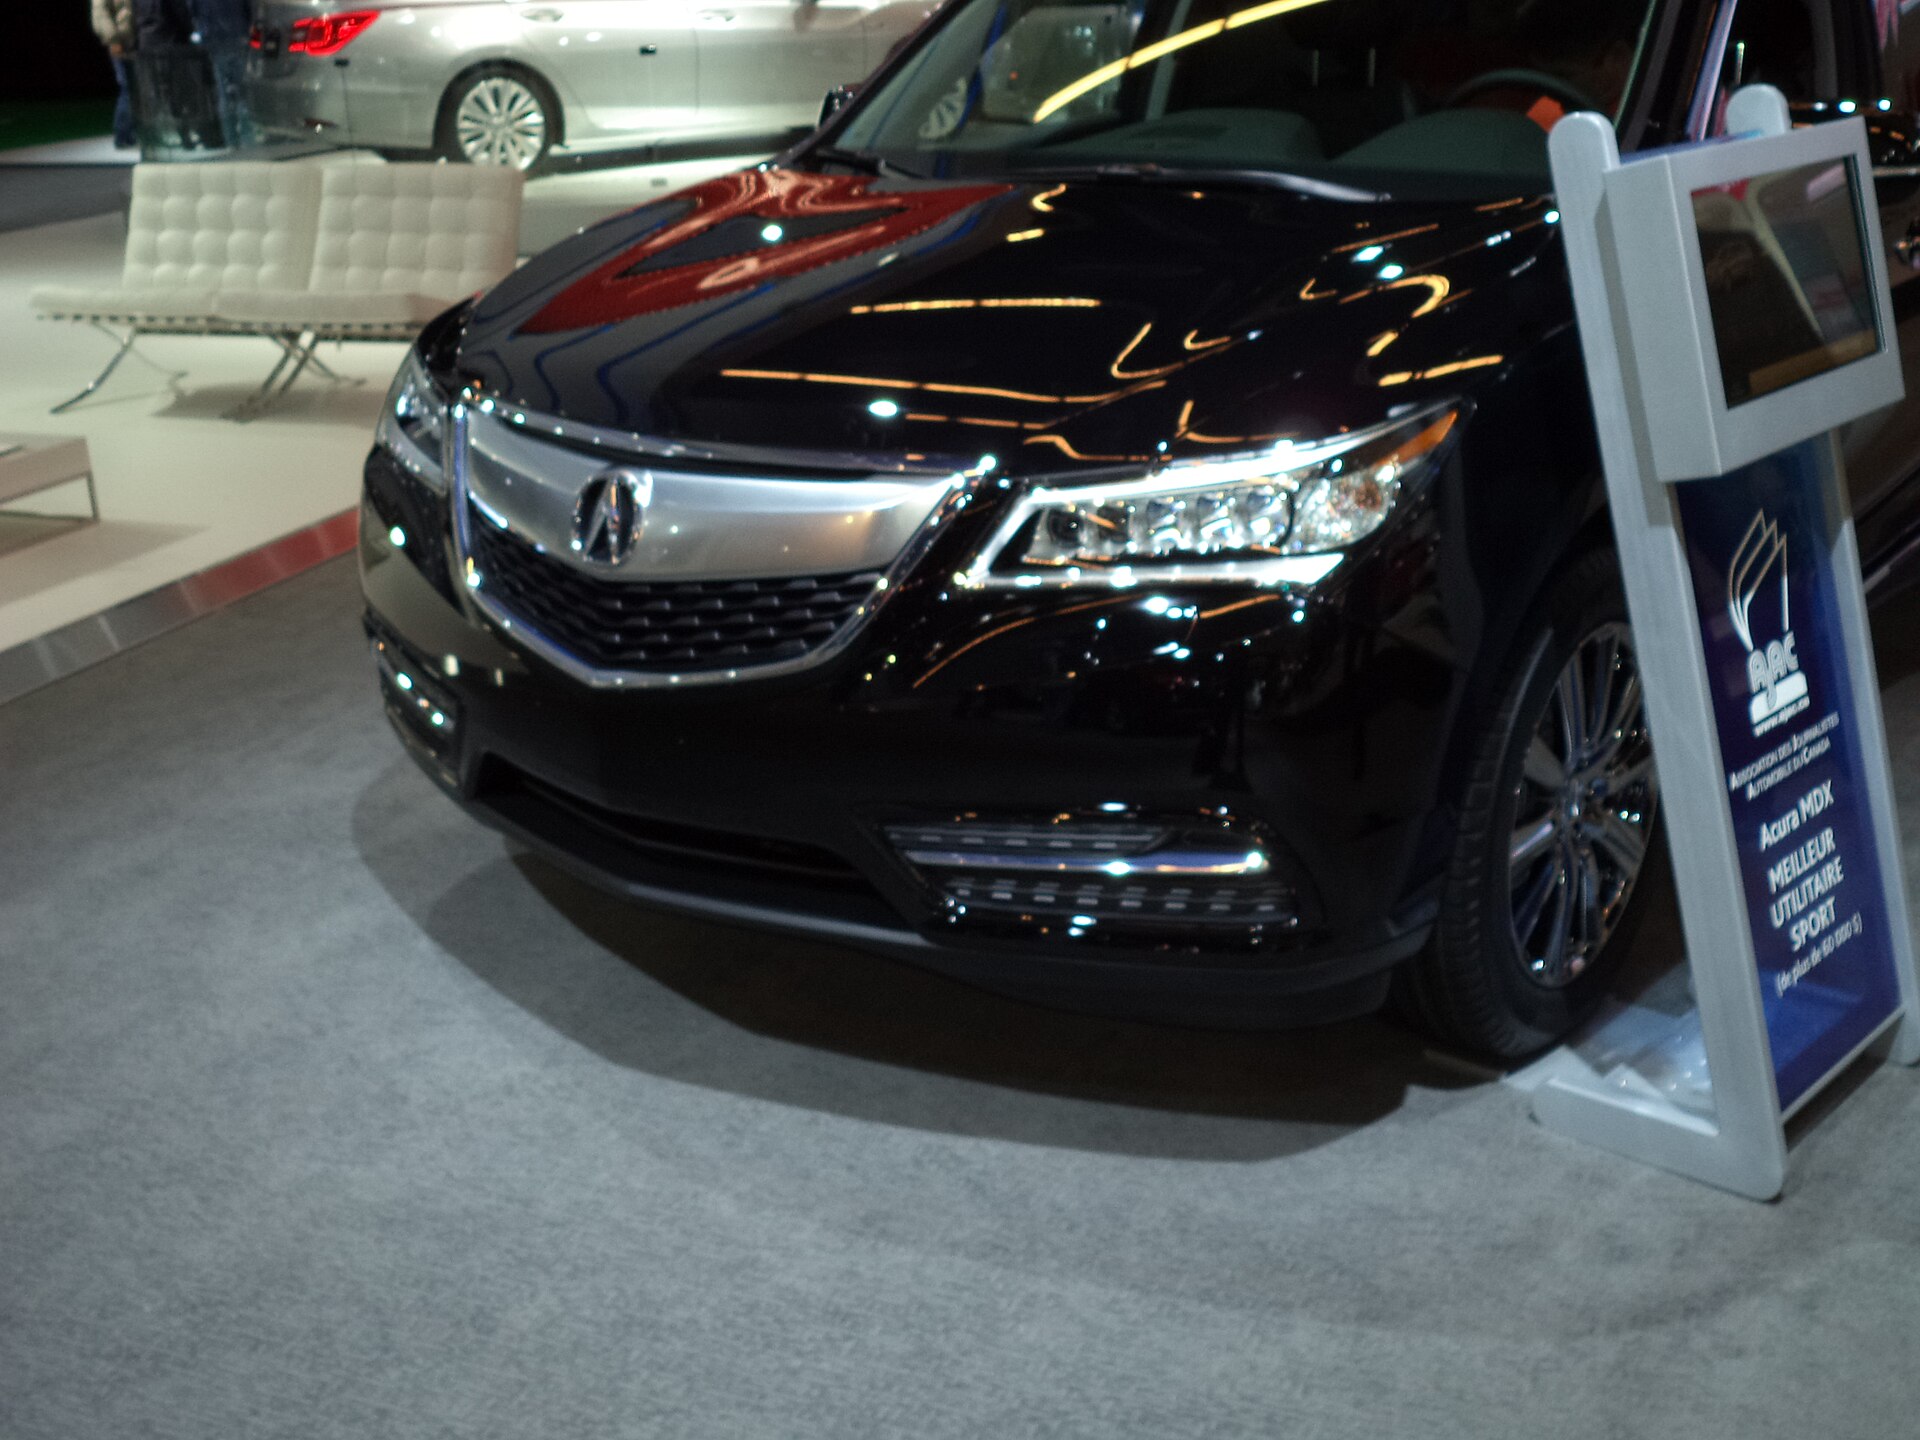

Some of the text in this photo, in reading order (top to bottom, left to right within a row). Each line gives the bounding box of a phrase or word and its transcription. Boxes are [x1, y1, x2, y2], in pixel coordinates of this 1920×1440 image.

[1760, 779, 1834, 852] Acura MDX
[1768, 827, 1836, 894] MEILLEUR
[1770, 856, 1844, 928] UTILITAIRE
[1790, 896, 1835, 952] SPORT
[1792, 959, 1811, 986] plus
[1811, 945, 1822, 967] de
